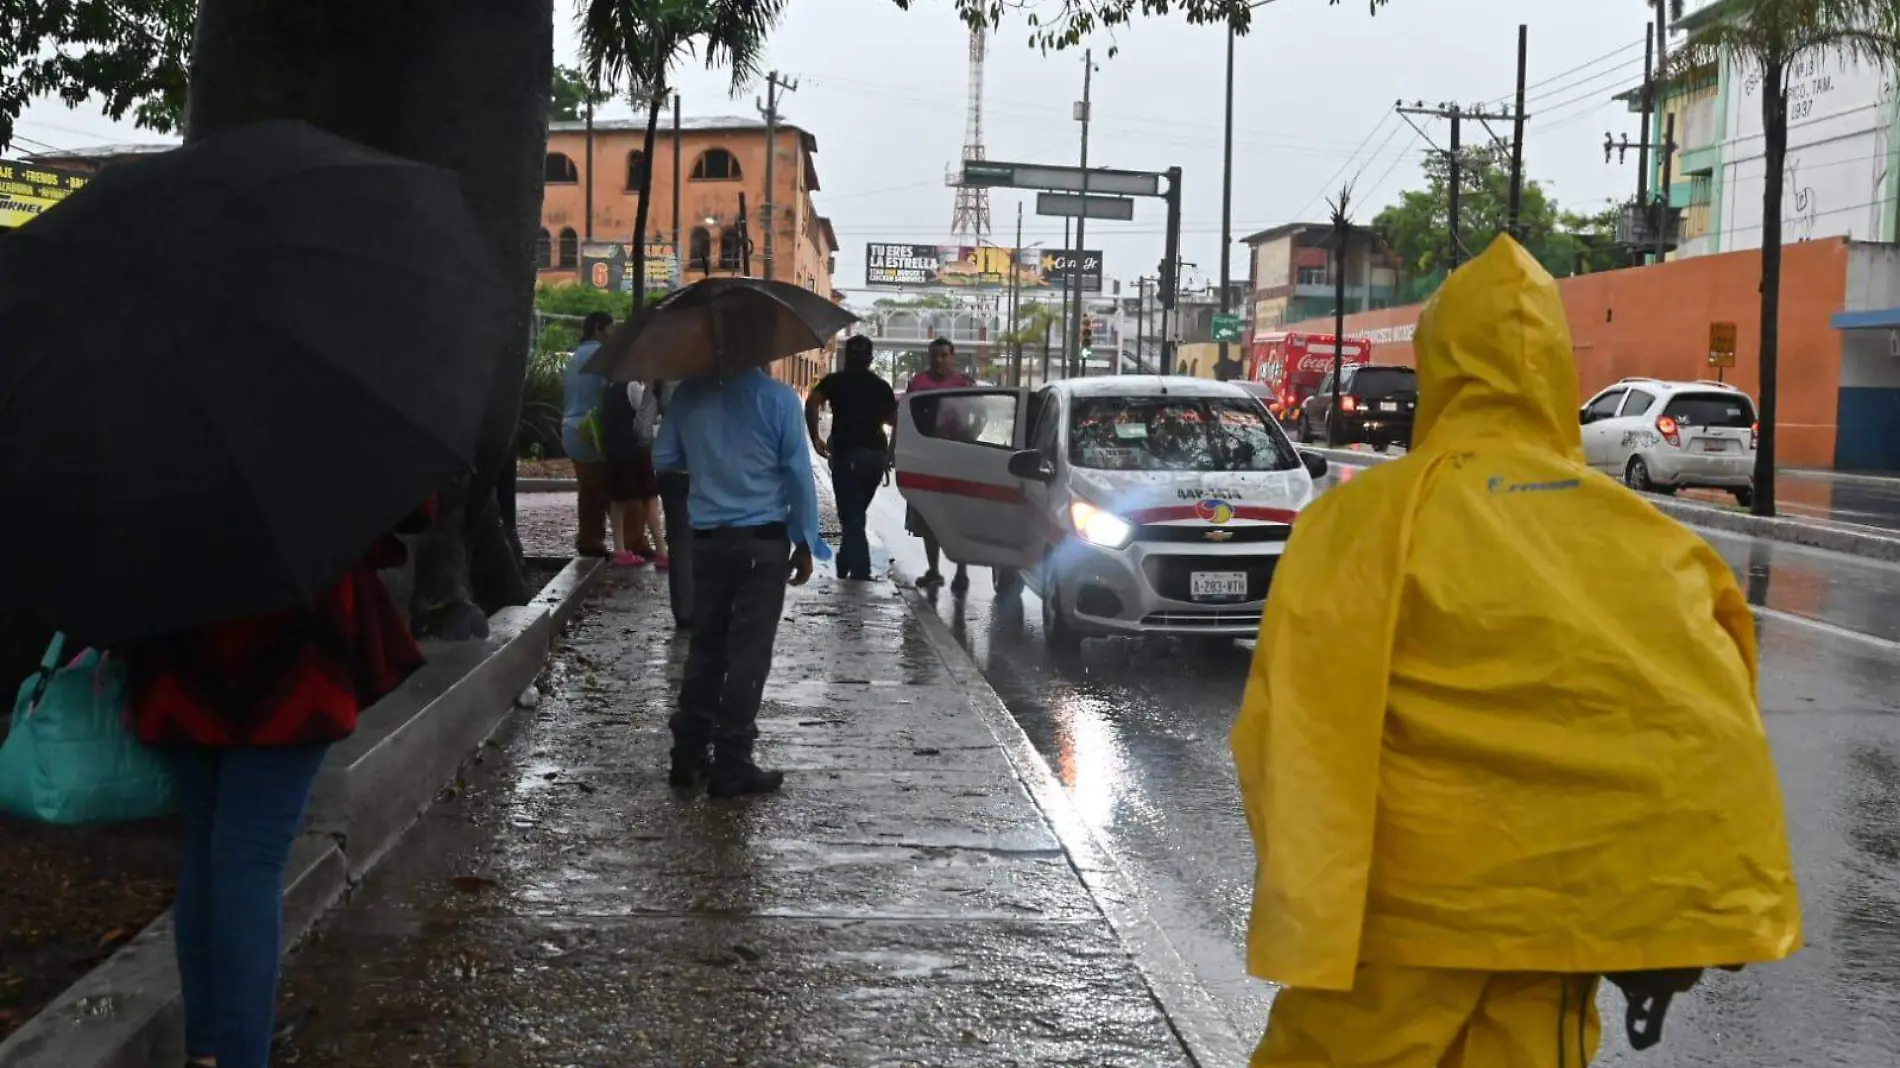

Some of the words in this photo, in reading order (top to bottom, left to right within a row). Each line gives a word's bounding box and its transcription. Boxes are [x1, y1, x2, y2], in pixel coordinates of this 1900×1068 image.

[1812, 76, 1834, 94] TAM.
[1791, 100, 1813, 120] 1937
[26, 169, 58, 186] FRENOS
[870, 245, 885, 257] TU
[886, 245, 914, 258] ERES
[870, 257, 884, 267] LA
[886, 258, 939, 270] ESTRELLA
[1194, 580, 1245, 594] A-283-VTH
